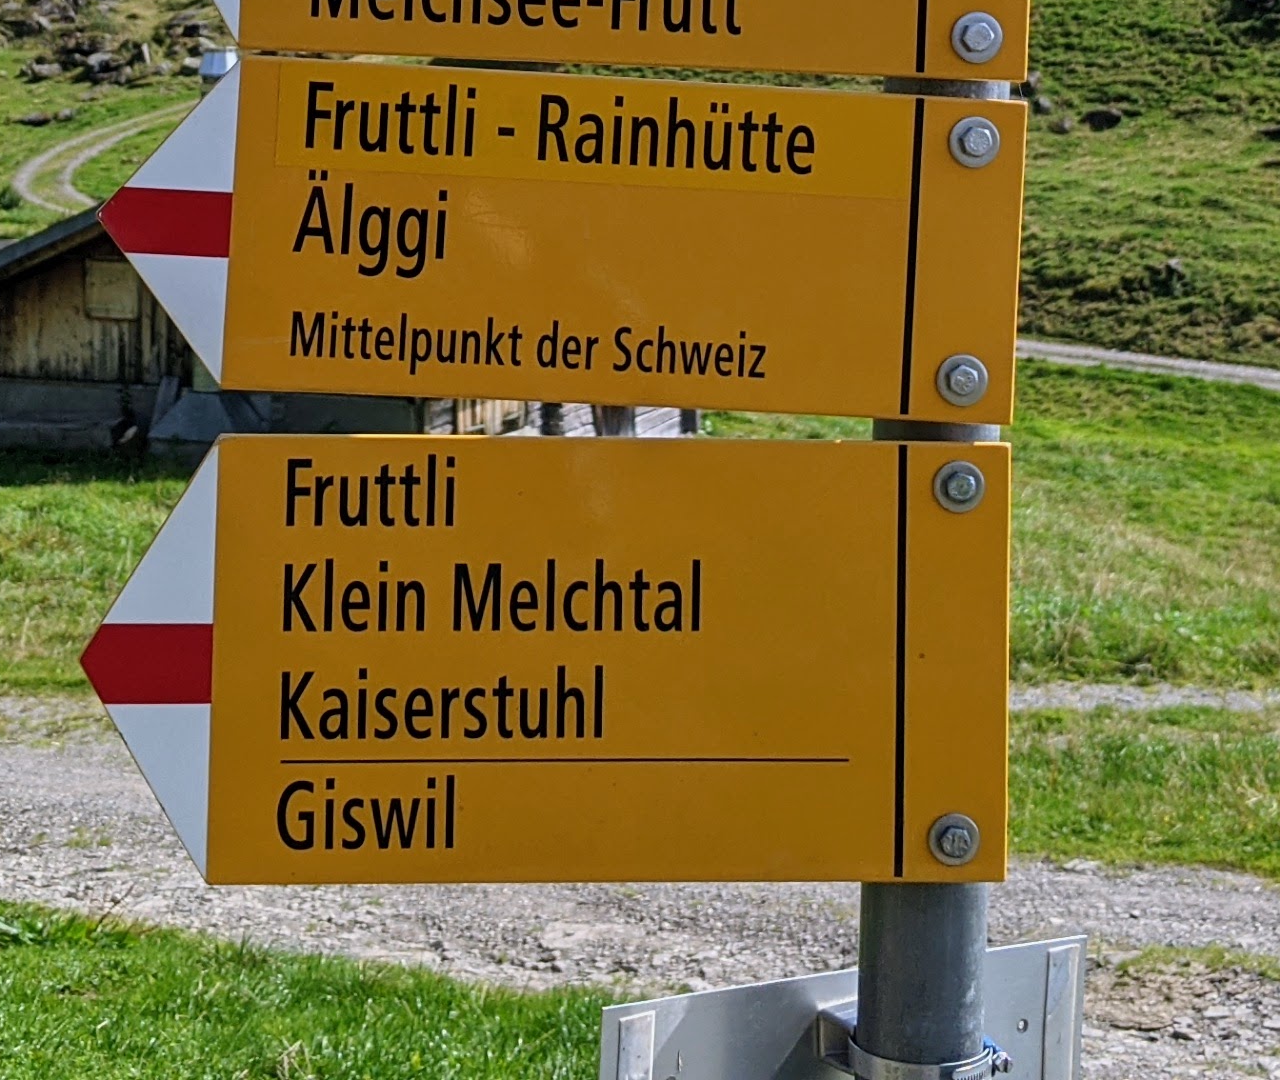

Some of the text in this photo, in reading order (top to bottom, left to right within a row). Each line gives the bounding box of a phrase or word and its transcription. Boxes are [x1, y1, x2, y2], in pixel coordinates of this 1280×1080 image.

[304, 80, 477, 158] Fruttli
[537, 93, 815, 176] Rainhütte
[291, 168, 448, 279] Älggi
[289, 310, 767, 379] Mittelpunkt der Schweiz
[285, 453, 456, 528] Fruttli
[282, 557, 702, 633] Klein Melchtal
[280, 664, 604, 741] Kaiserstuhl
[276, 774, 456, 851] Giswil
